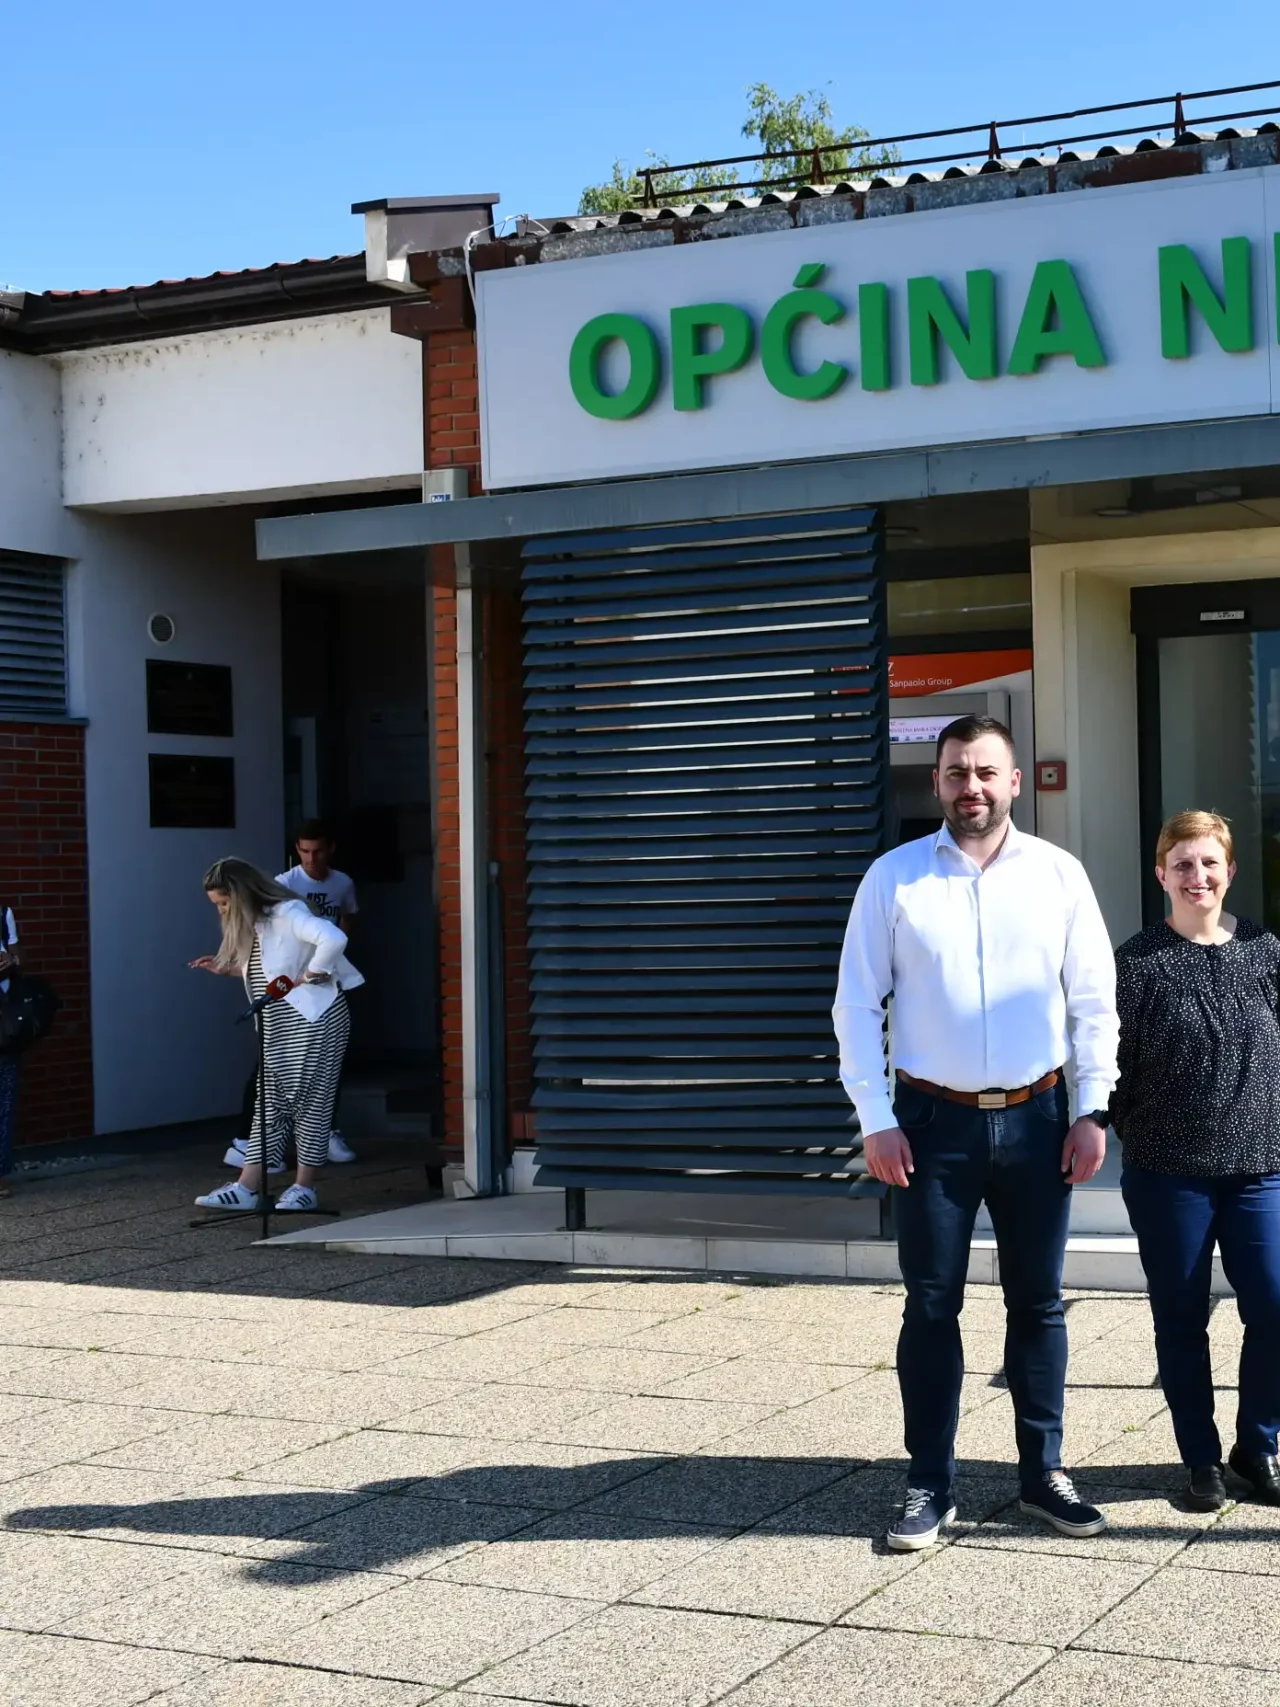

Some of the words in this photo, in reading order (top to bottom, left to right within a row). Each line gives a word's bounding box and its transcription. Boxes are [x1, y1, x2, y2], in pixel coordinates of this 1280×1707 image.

[569, 261, 1106, 420] OPĆINA
[889, 678, 926, 689] Sanpaolo
[927, 677, 953, 686] Group
